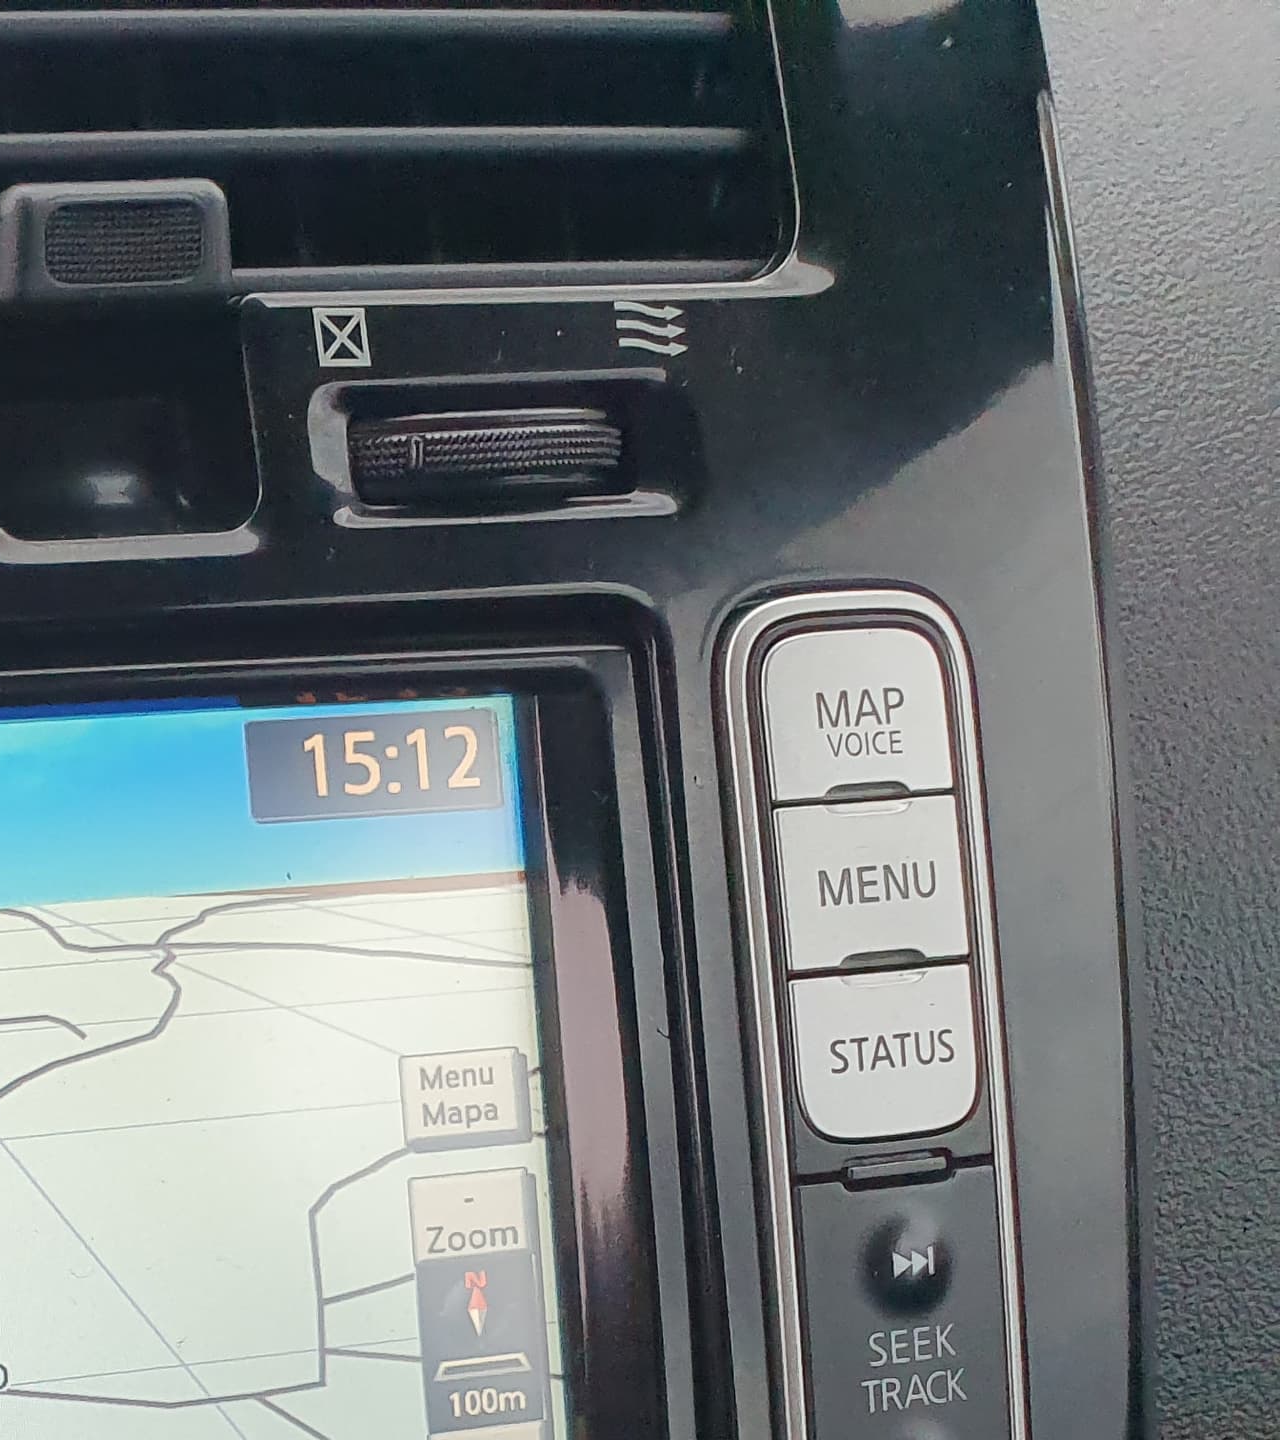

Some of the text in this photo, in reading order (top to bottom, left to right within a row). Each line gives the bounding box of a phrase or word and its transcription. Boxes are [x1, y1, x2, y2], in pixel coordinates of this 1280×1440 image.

[815, 686, 906, 730] MAP
[302, 724, 482, 798] 15:12
[826, 730, 904, 757] VOICE
[817, 860, 938, 908] MENU
[829, 1028, 956, 1075] STATUS
[418, 1064, 495, 1092] Menu
[421, 1101, 500, 1130] Mapa
[425, 1221, 519, 1255] Zoom
[867, 1322, 958, 1369] SEEK
[448, 1387, 527, 1419] 100m
[860, 1367, 968, 1414] TRACK
